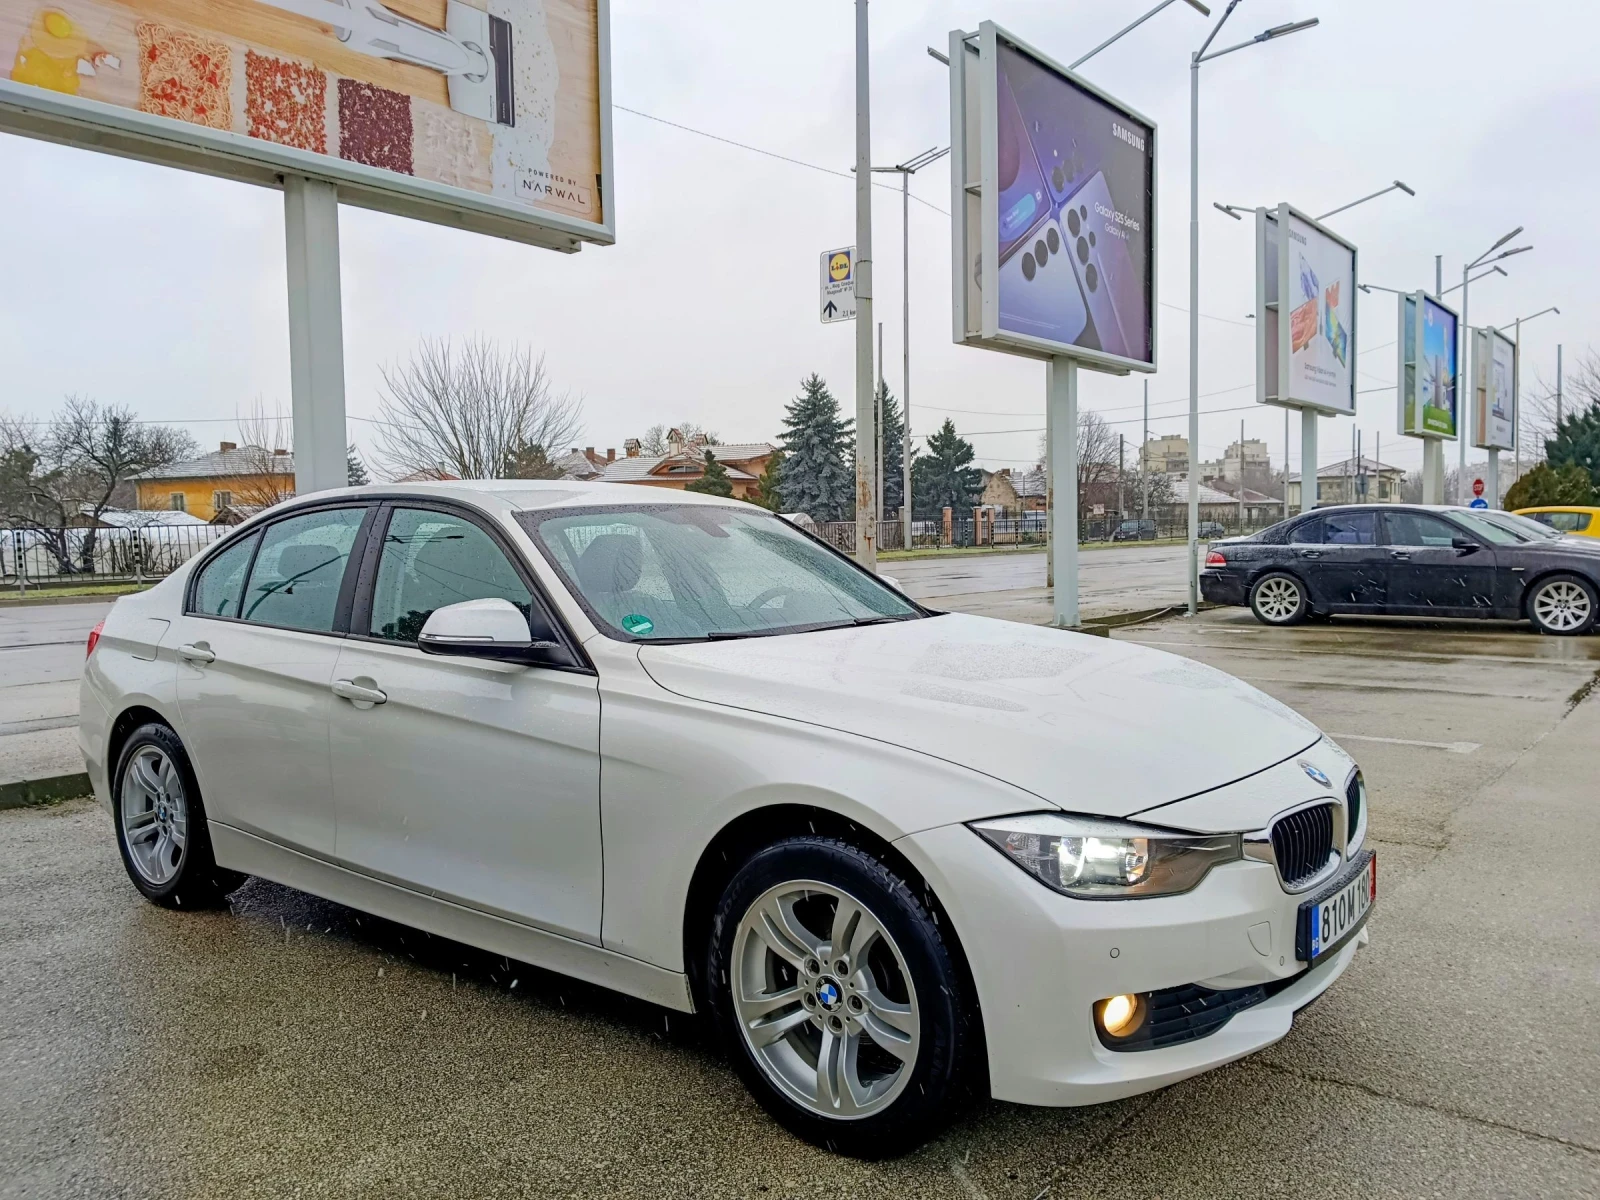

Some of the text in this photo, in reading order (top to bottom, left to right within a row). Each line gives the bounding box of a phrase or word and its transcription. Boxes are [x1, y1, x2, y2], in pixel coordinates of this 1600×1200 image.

[1112, 122, 1145, 152] SAMSUNG
[528, 167, 577, 187] POWERED BY
[523, 179, 586, 205] NARWAL
[1094, 201, 1140, 232] Galaxy S25 Series
[1104, 222, 1121, 240] Galaxy
